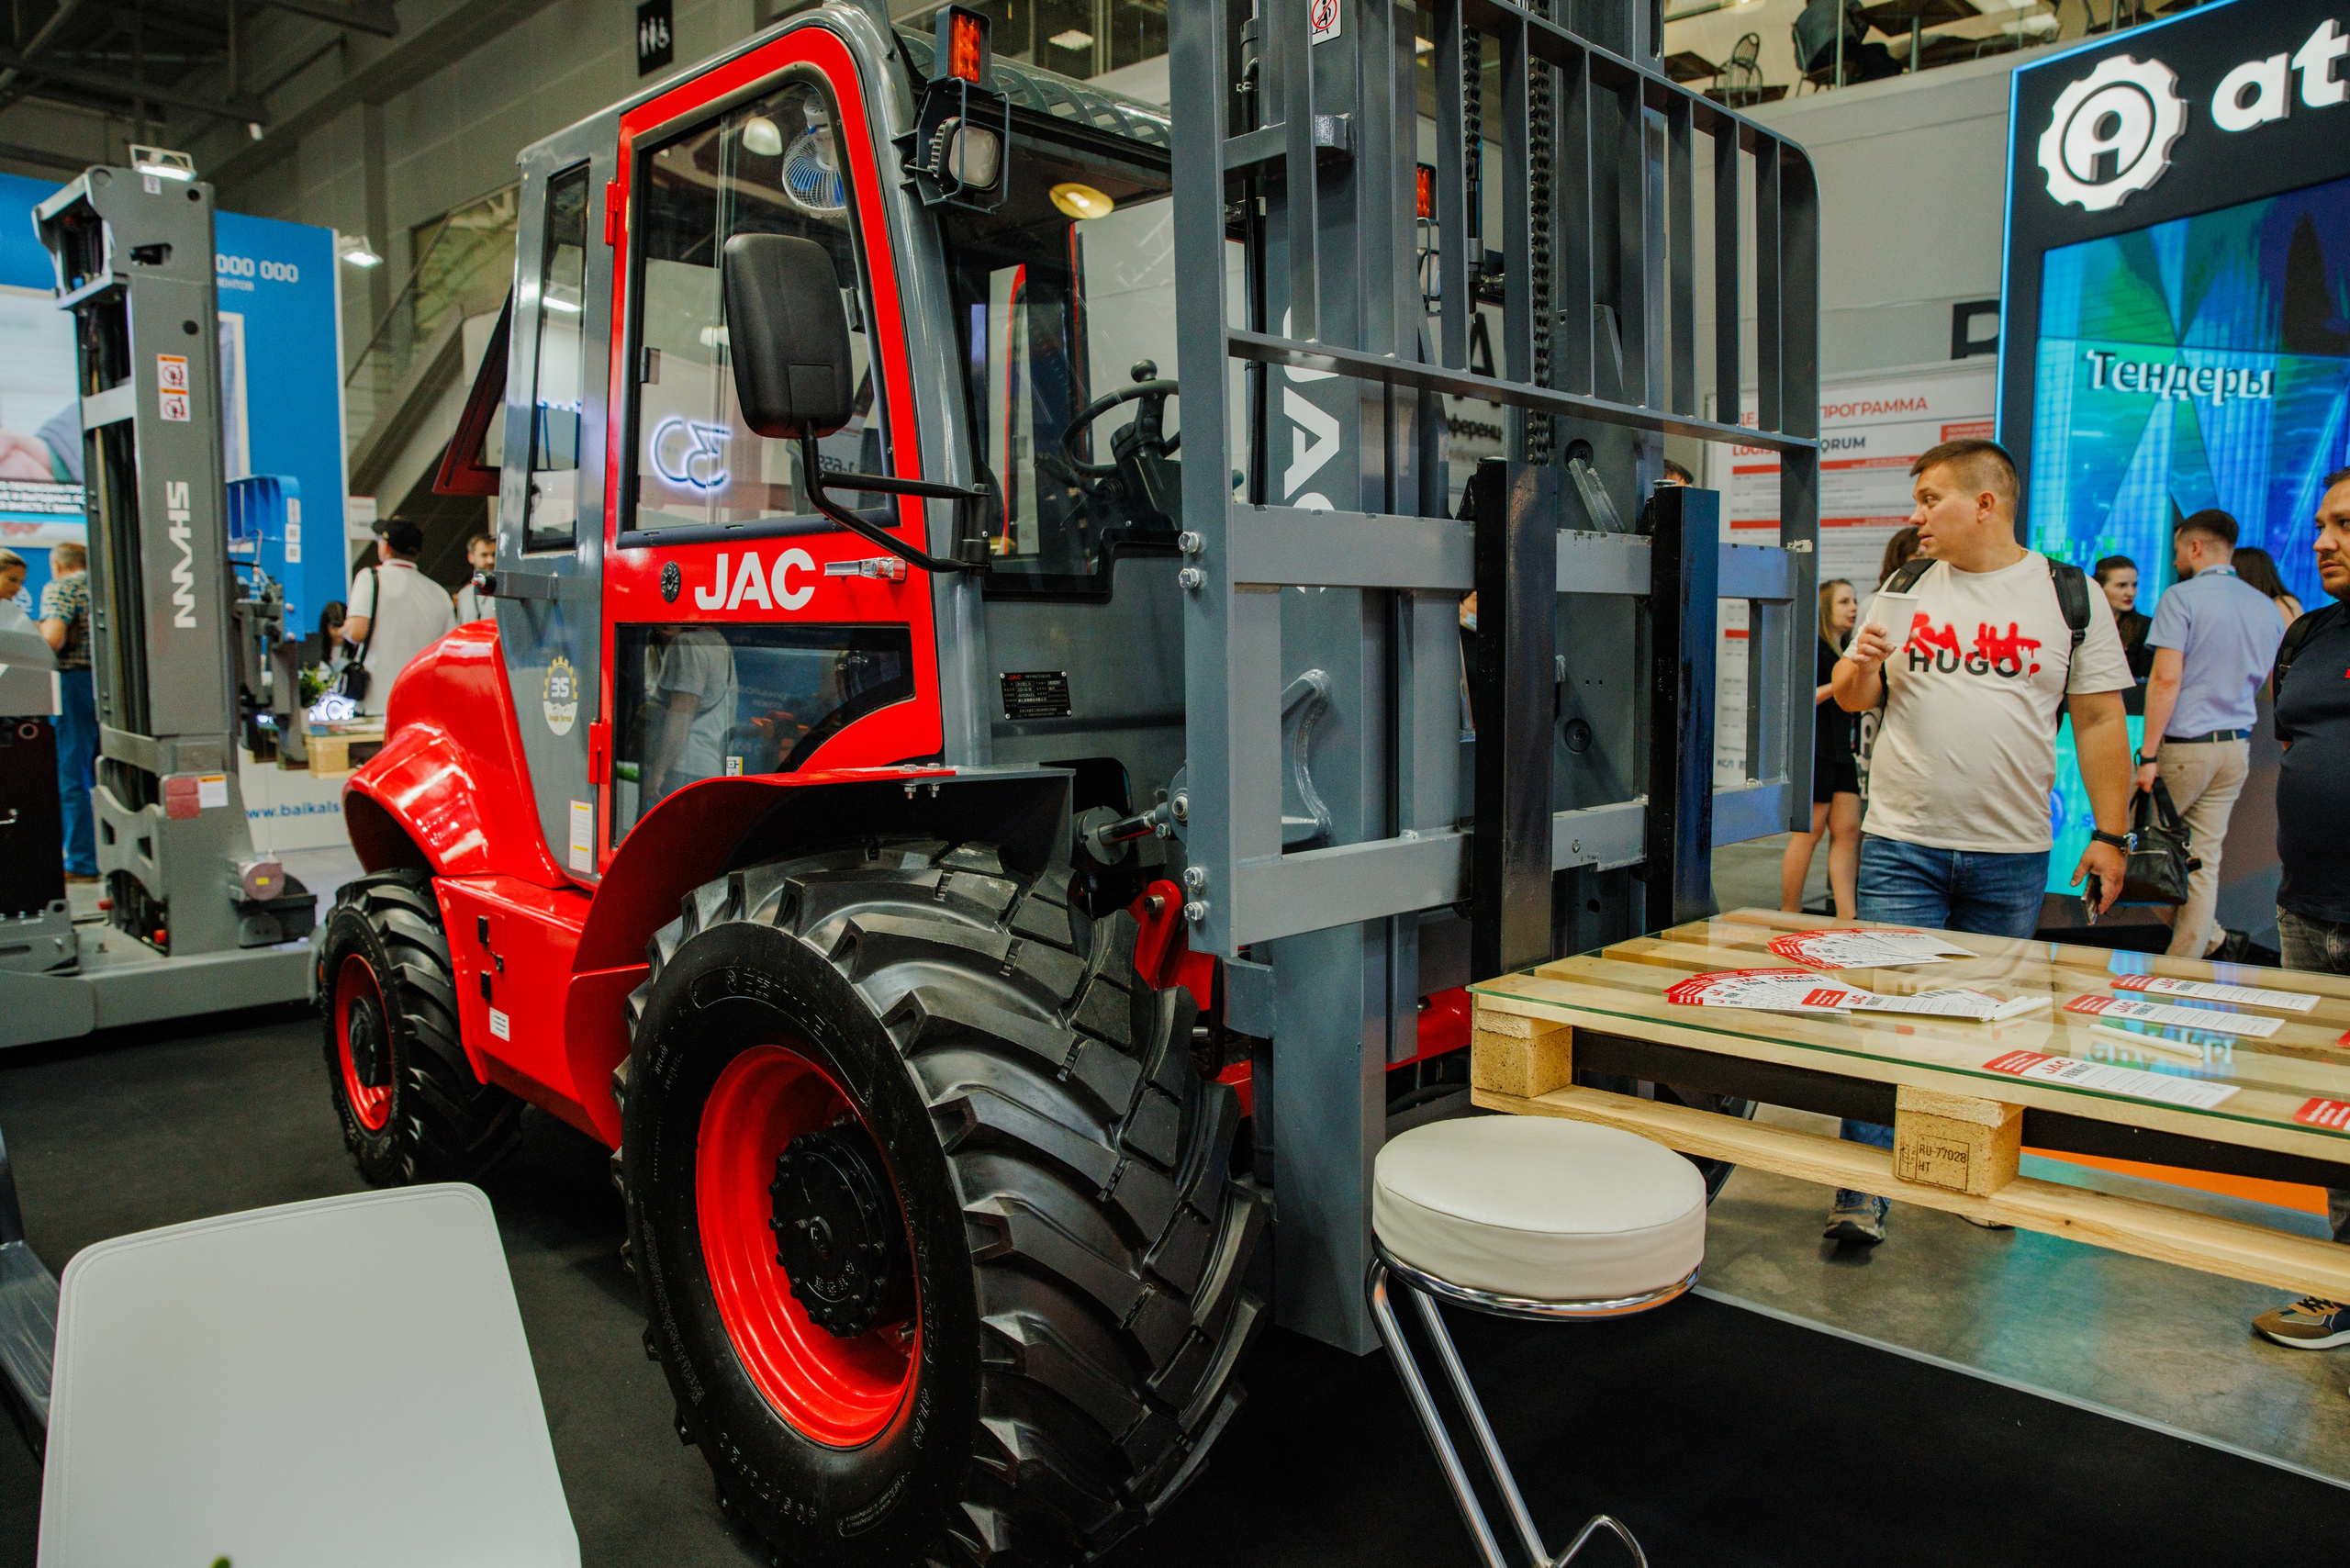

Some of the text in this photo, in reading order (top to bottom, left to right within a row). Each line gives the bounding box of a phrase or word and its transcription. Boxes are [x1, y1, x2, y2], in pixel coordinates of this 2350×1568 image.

[260, 260, 299, 284] 000
[2086, 349, 2275, 406] Тендеры
[1283, 306, 1339, 593] JA
[695, 548, 816, 610] JAC
[1908, 647, 2022, 678] HUGO
[551, 677, 569, 698] 35
[2113, 1002, 2139, 1014] JAC
[2041, 1059, 2075, 1074] JAC
[1919, 1143, 1967, 1164] RU-77028
[1918, 1159, 1931, 1173] HT
